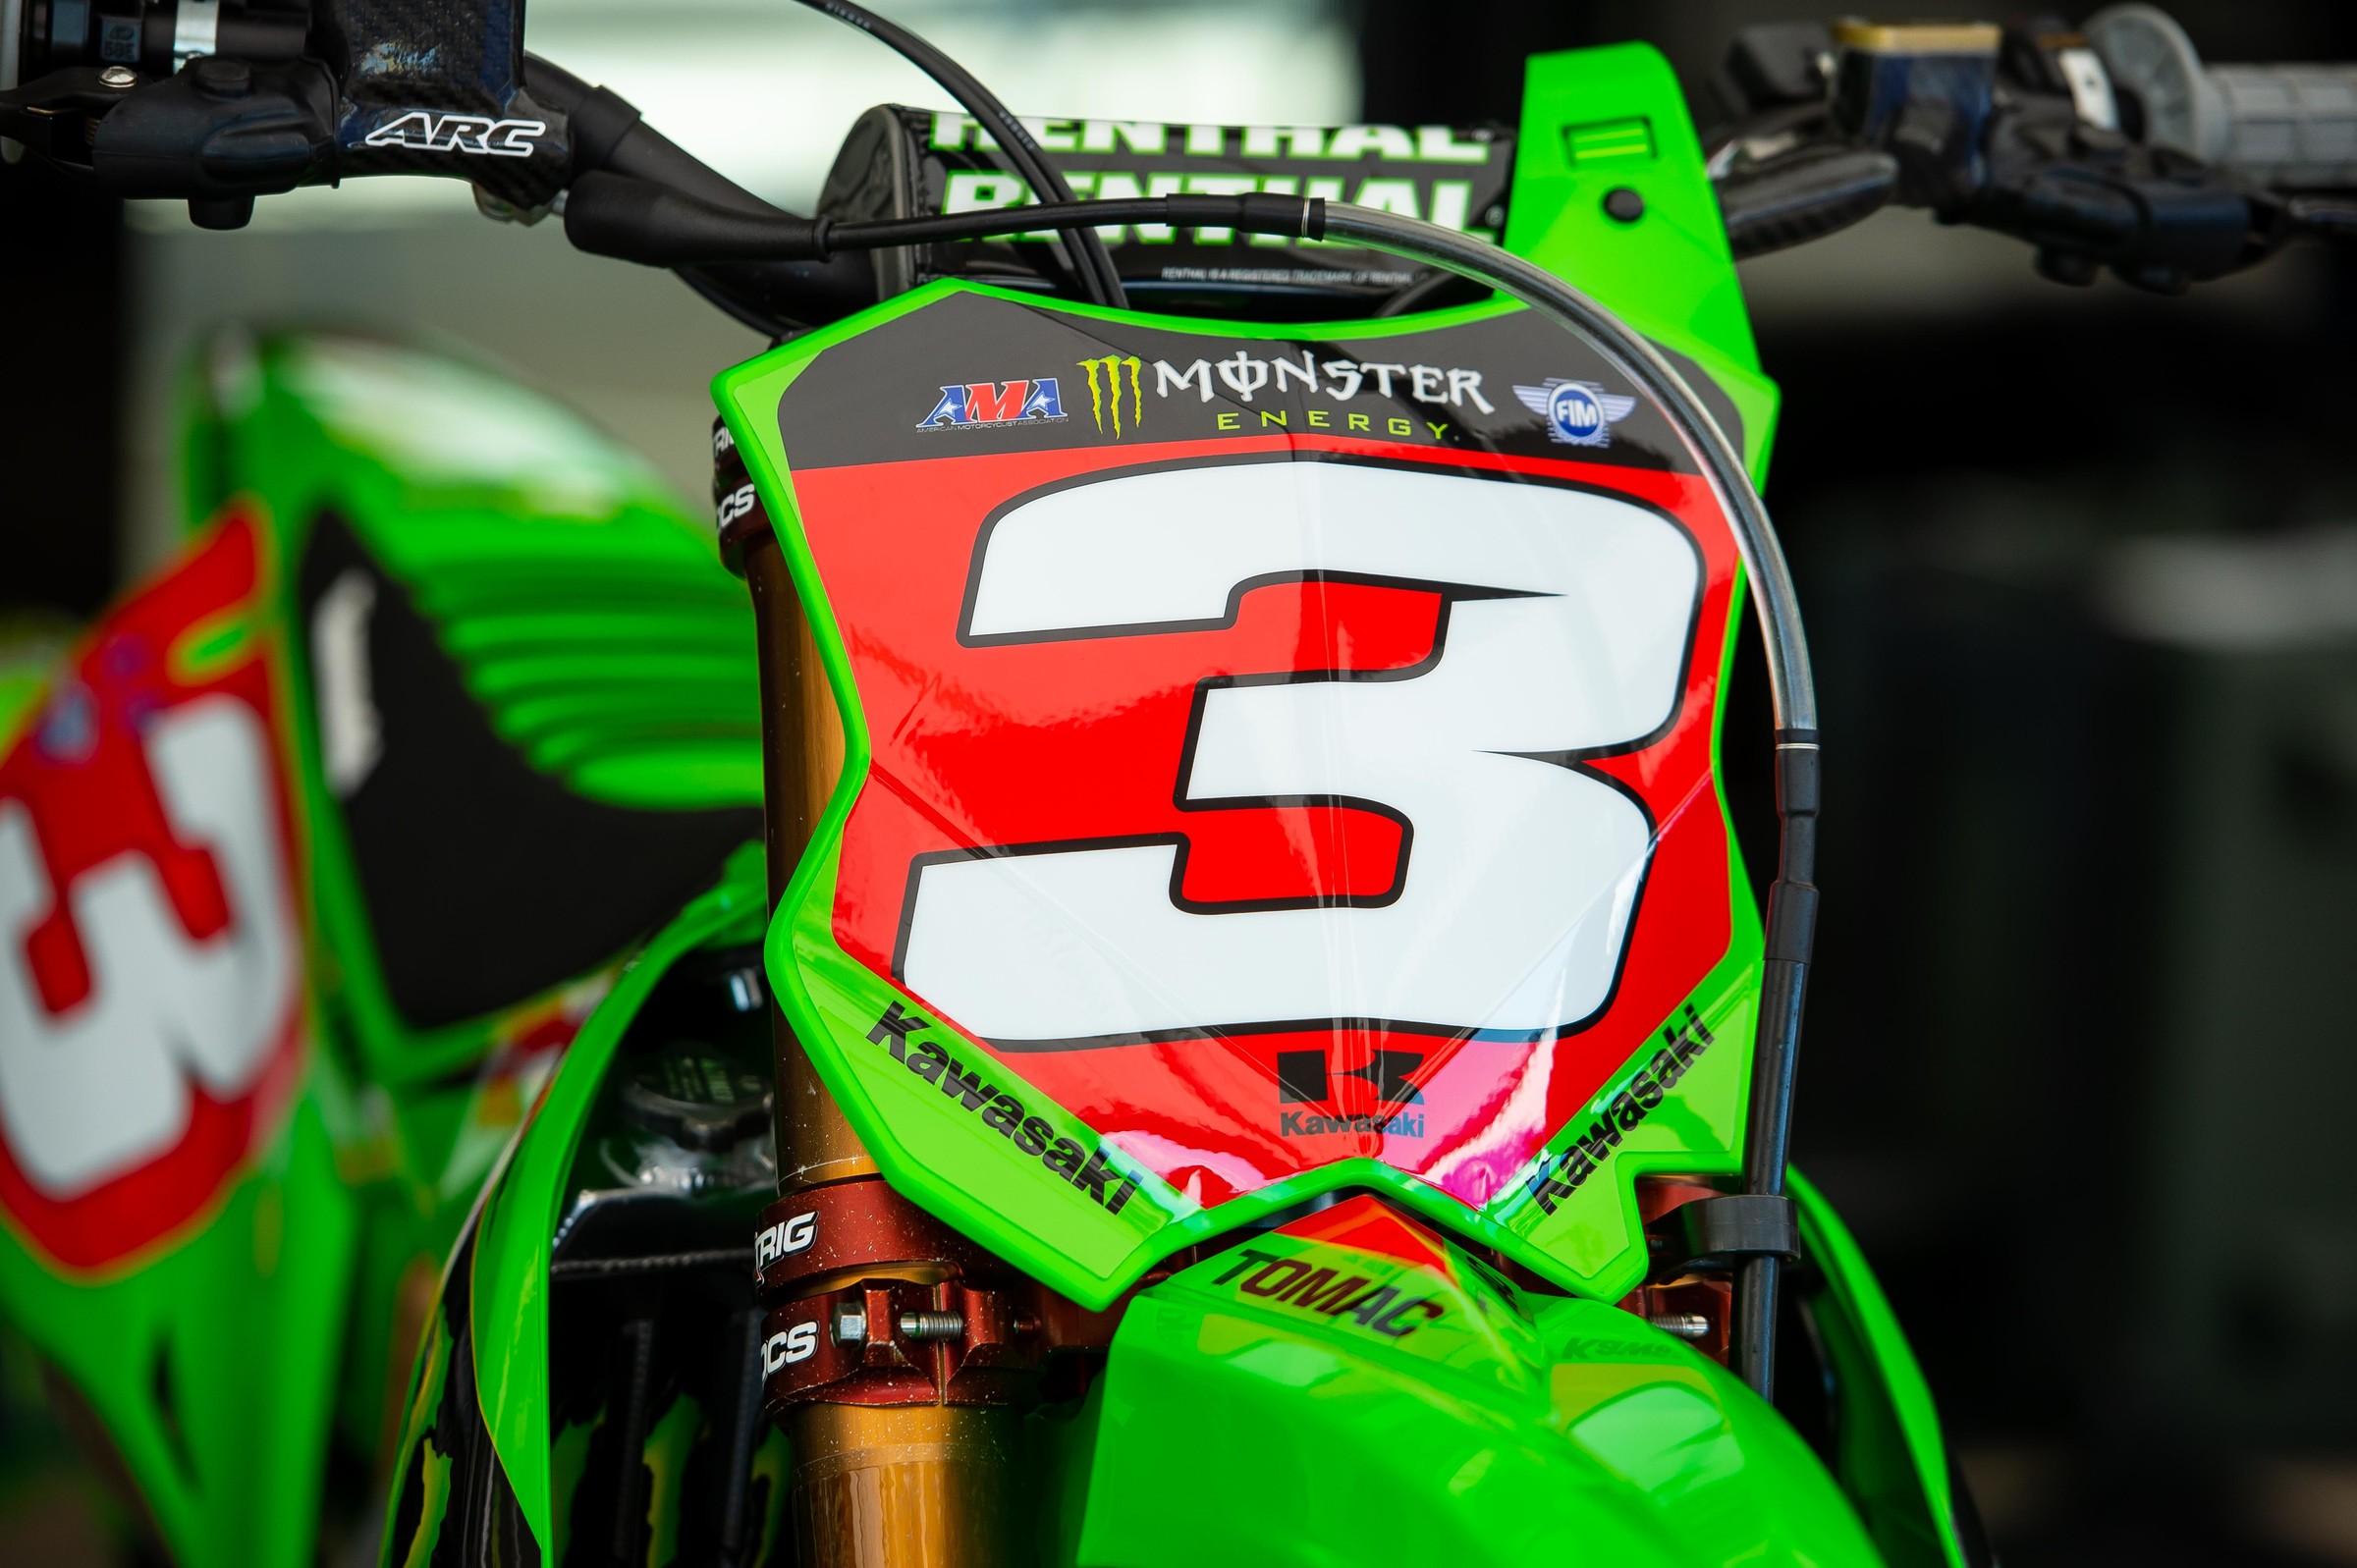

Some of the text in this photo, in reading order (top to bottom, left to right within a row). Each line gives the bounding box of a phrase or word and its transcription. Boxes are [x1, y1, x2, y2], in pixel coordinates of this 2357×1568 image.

[365, 112, 546, 157] ARC
[916, 378, 1068, 428] AMA
[1152, 351, 1495, 414] MONSTER
[916, 417, 1069, 434] AMERICAN MOTORCYCLIST ASSOCIATION
[1218, 410, 1450, 439] ENERGY
[1556, 399, 1598, 427] FIM
[892, 450, 1705, 1053] 3
[0, 687, 299, 1202] 3
[865, 1000, 1143, 1216] Kawasaki
[1280, 1110, 1424, 1138] Kawasaki
[1525, 1002, 1715, 1216] Kawasaki
[1211, 1248, 1445, 1338] TOMAC
